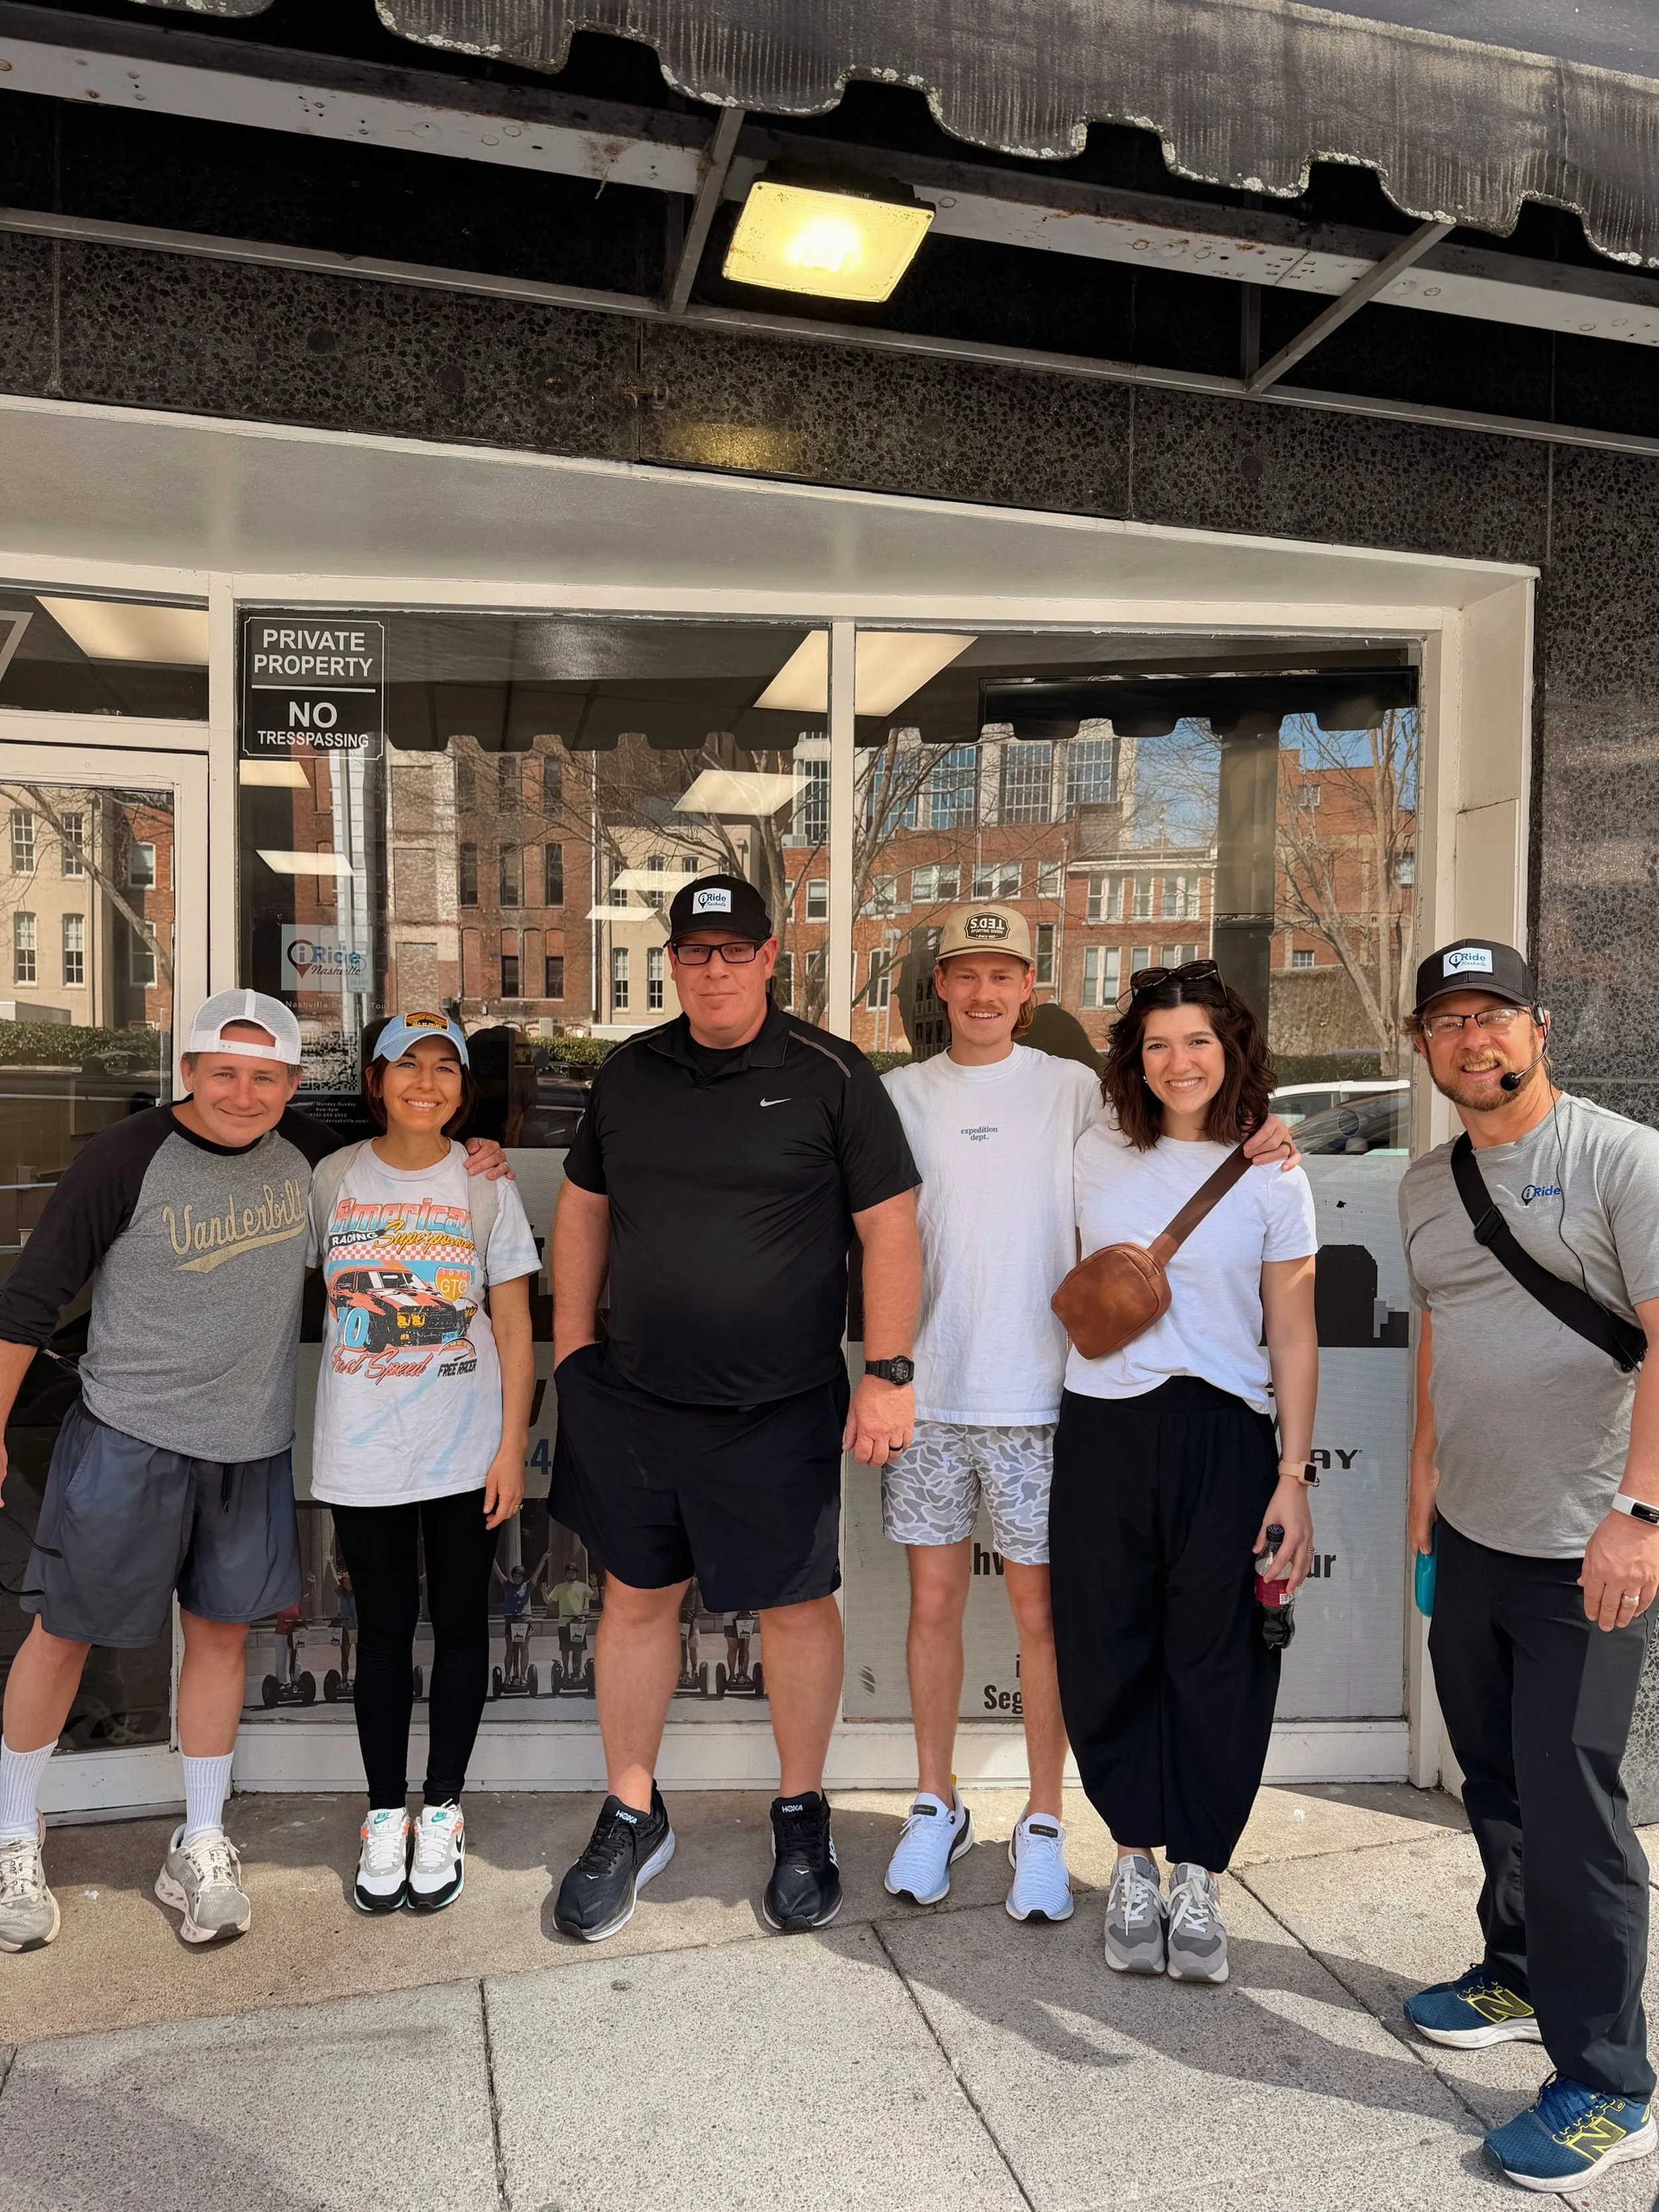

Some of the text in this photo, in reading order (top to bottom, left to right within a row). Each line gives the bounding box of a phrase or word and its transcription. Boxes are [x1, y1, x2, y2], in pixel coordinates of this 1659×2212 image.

[263, 629, 365, 651] PRIVATE
[254, 654, 373, 677] PROPERTY
[289, 701, 338, 728] NO
[257, 731, 369, 748] TRESSPASSING
[961, 1126, 998, 1135] expedition
[163, 1179, 305, 1256] Vanderbilt
[332, 1232, 379, 1246] RACING
[440, 1278, 468, 1298] GTO
[366, 1347, 434, 1385] Speed
[437, 1359, 477, 1377] FREE RACER
[984, 1684, 1024, 1715] Seg
[615, 1810, 637, 1824] HOKA
[782, 1805, 803, 1813] HOKA
